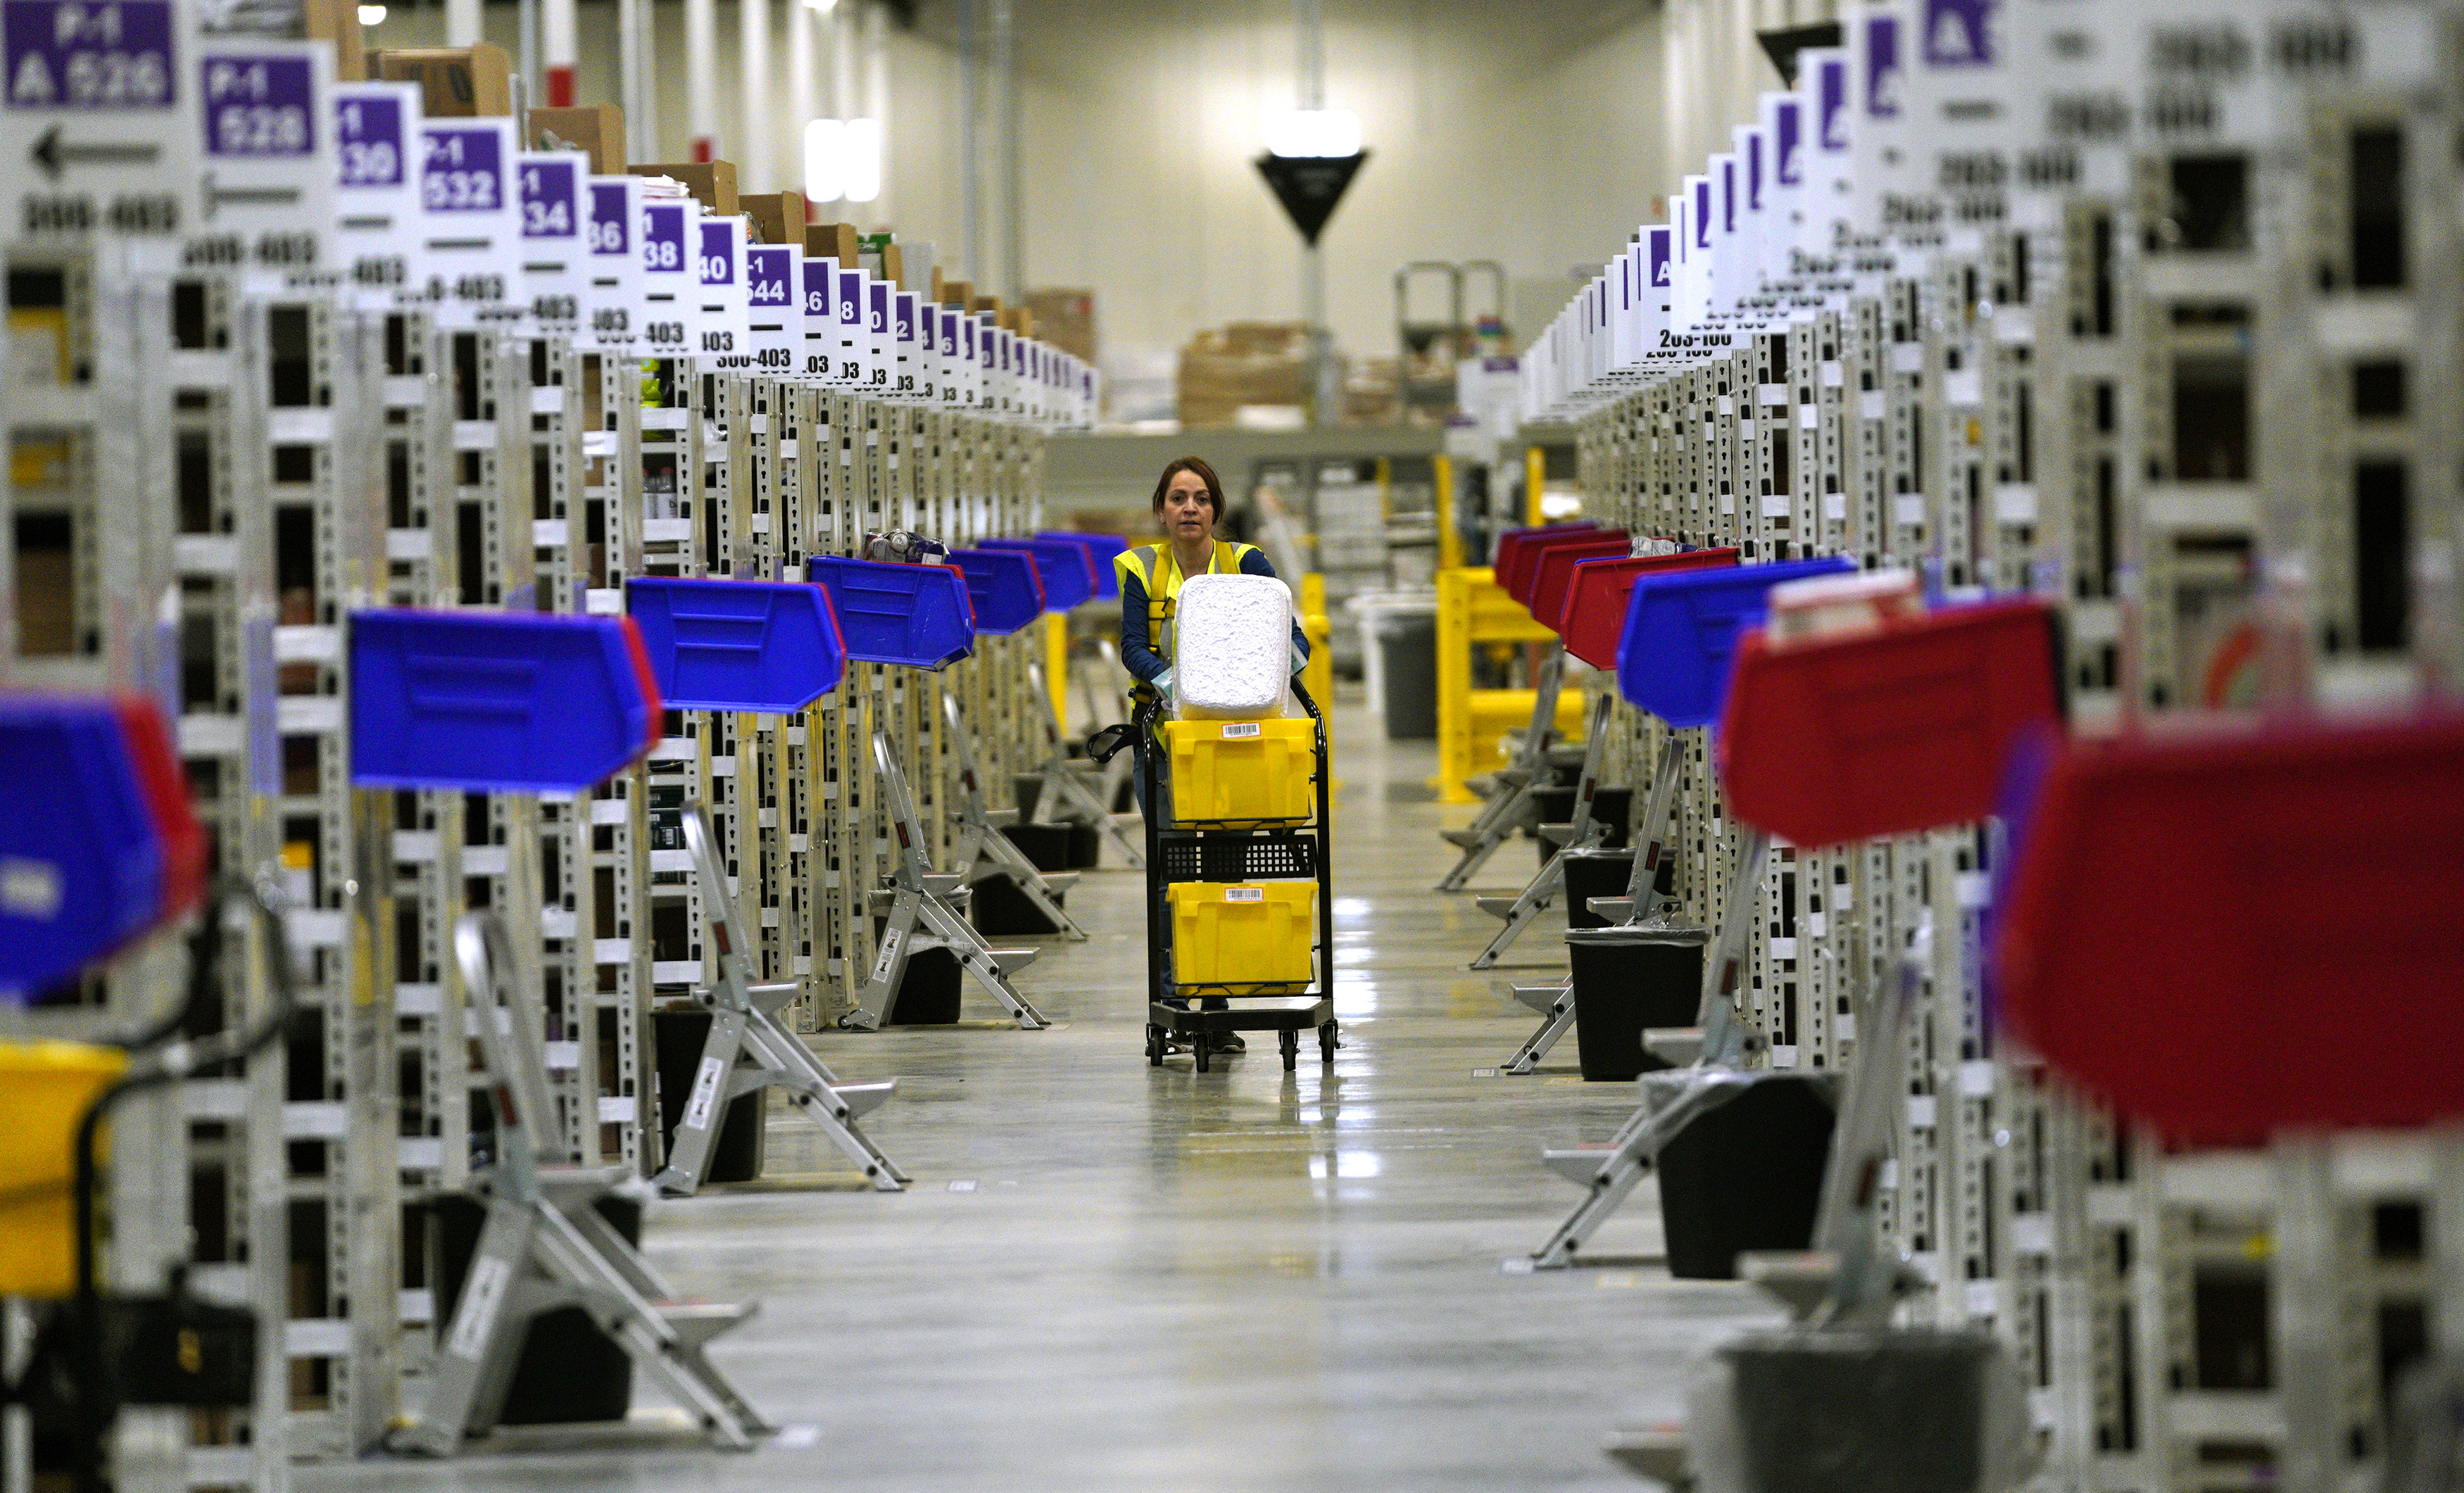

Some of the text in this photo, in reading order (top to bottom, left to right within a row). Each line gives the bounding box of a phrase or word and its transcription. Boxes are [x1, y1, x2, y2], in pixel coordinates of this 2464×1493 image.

[13, 49, 56, 101] A
[425, 170, 495, 206] 532
[524, 200, 570, 232] 34
[643, 240, 679, 268] 38
